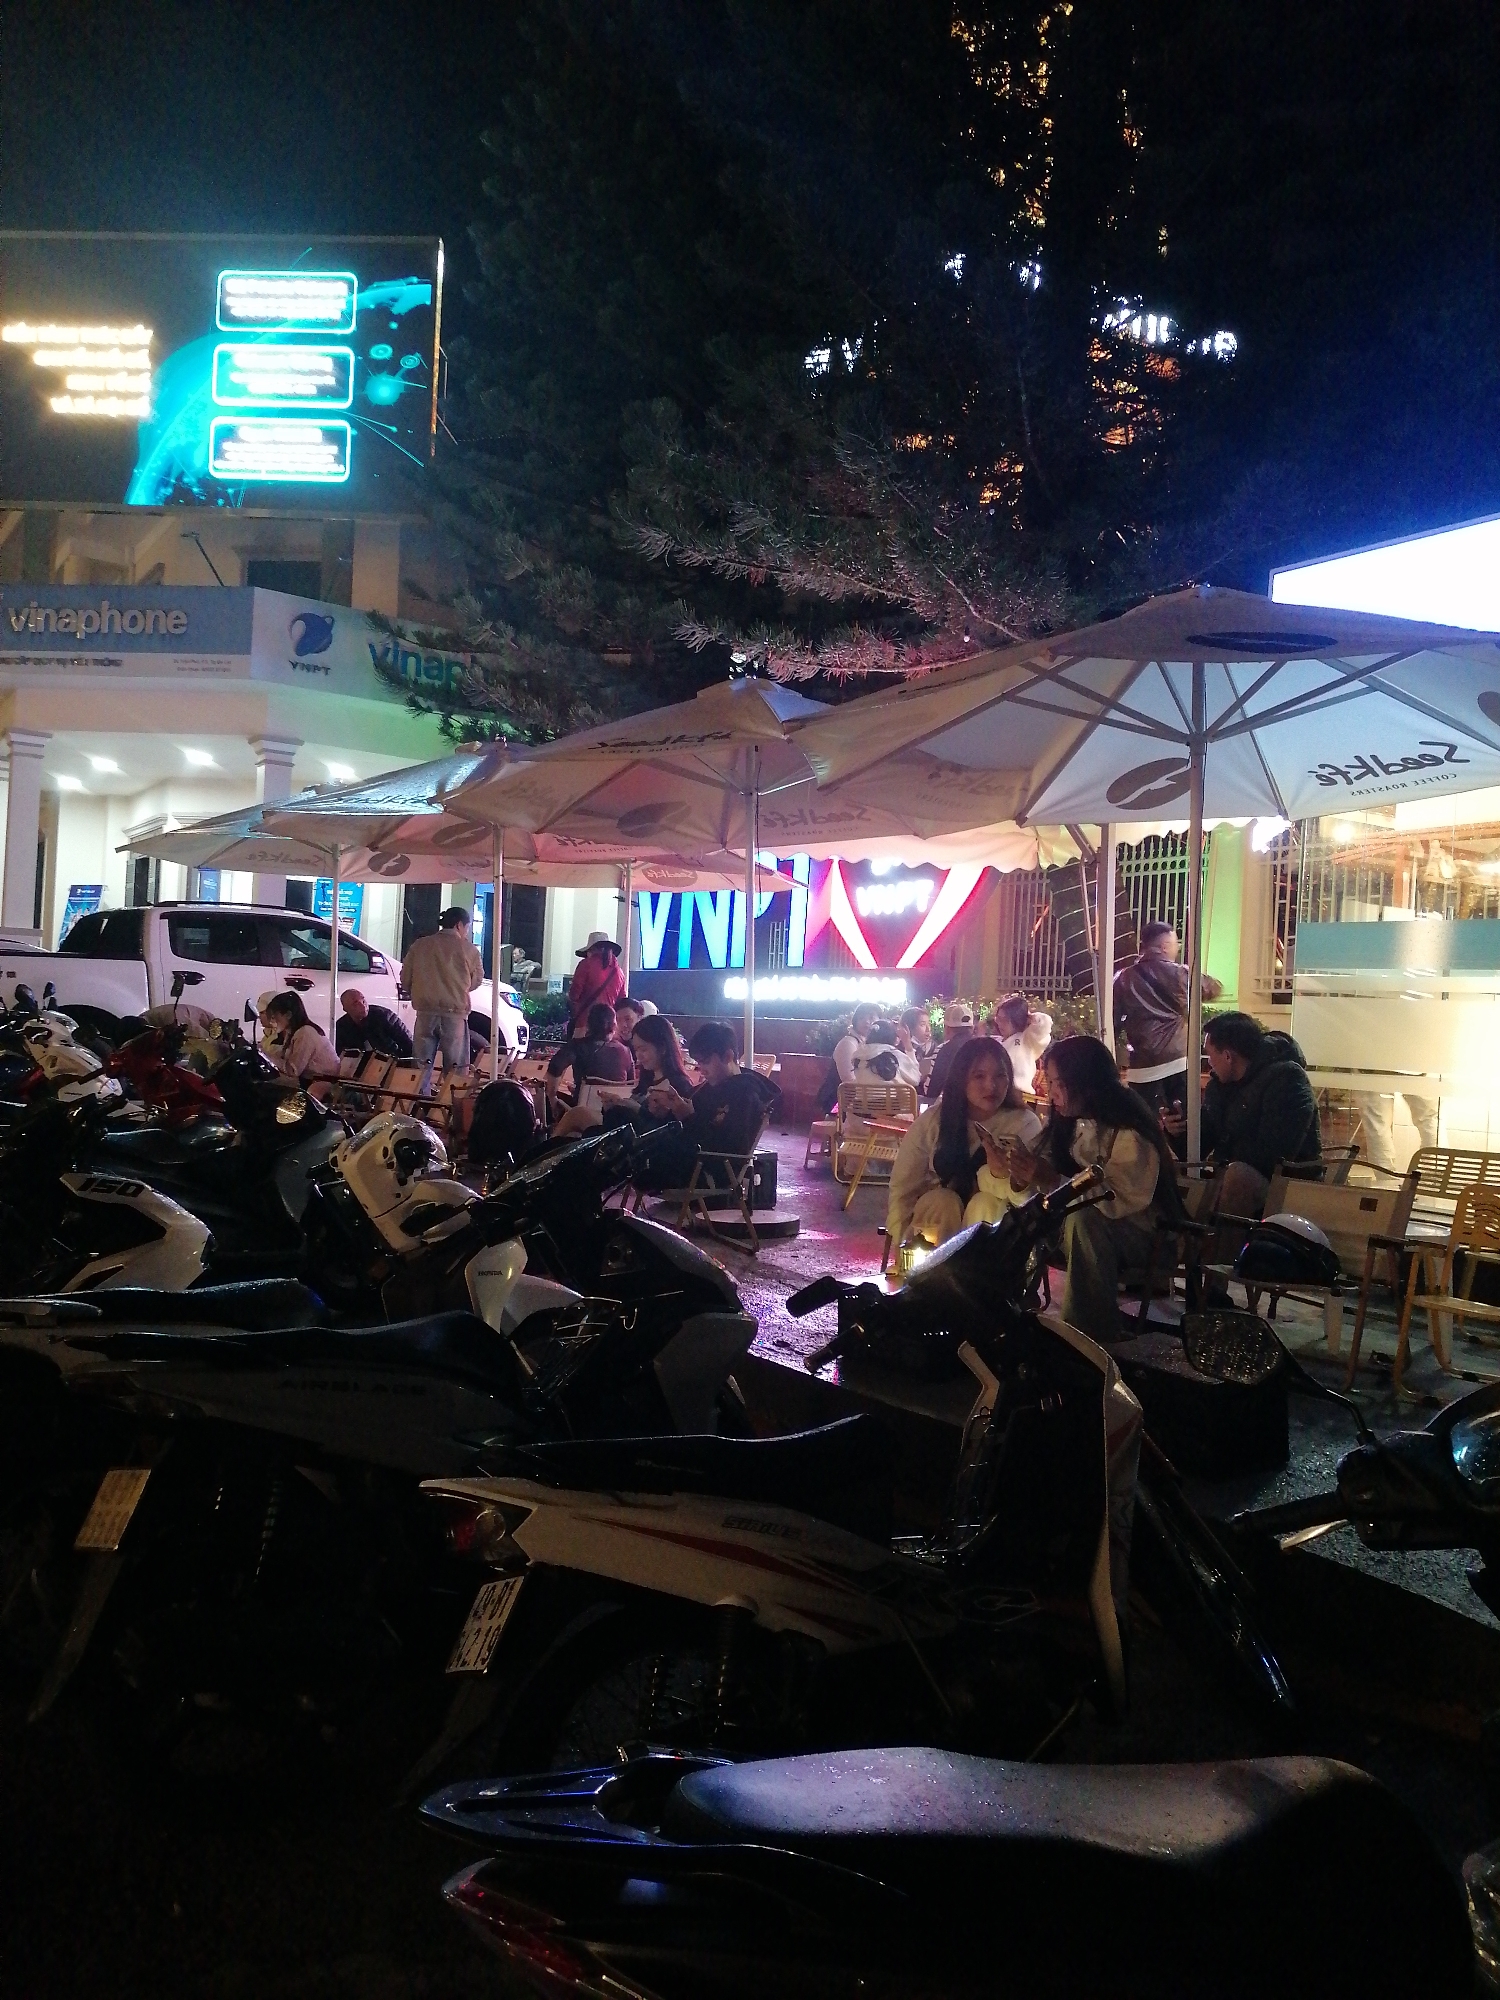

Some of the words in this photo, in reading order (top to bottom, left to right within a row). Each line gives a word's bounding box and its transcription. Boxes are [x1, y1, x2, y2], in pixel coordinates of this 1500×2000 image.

[8, 601, 188, 640] vinaphone
[288, 660, 332, 676] VNPT
[855, 879, 934, 917] VNPT
[77, 1177, 145, 1198] 150
